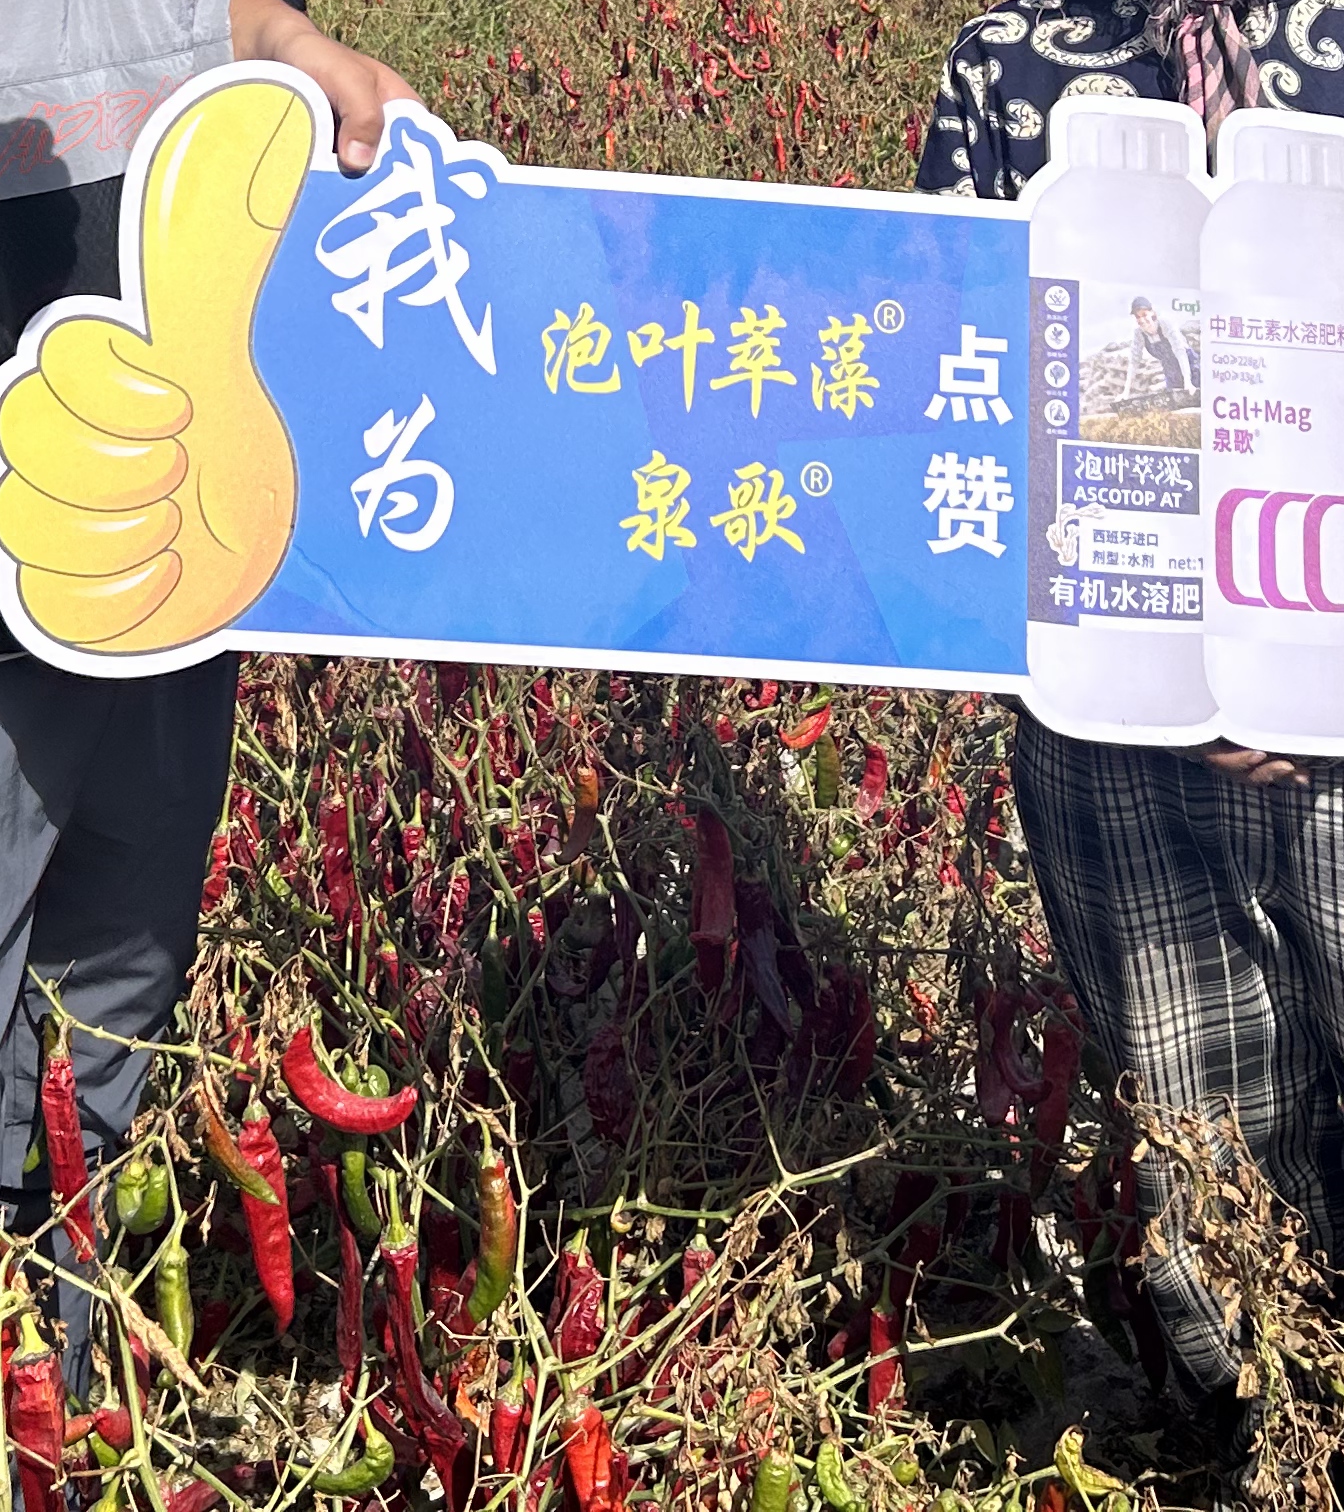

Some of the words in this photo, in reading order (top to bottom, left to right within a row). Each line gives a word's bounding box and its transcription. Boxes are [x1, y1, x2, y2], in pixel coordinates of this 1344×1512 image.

[315, 128, 497, 553] 我为
[1212, 396, 1312, 432] Cal+Mag
[924, 325, 1015, 559] 点赞
[1073, 485, 1156, 507] ASCOTOP
[1159, 491, 1183, 508] AT
[1092, 528, 1159, 547] 西班牙进口
[1049, 574, 1201, 615] 有机水溶肥
